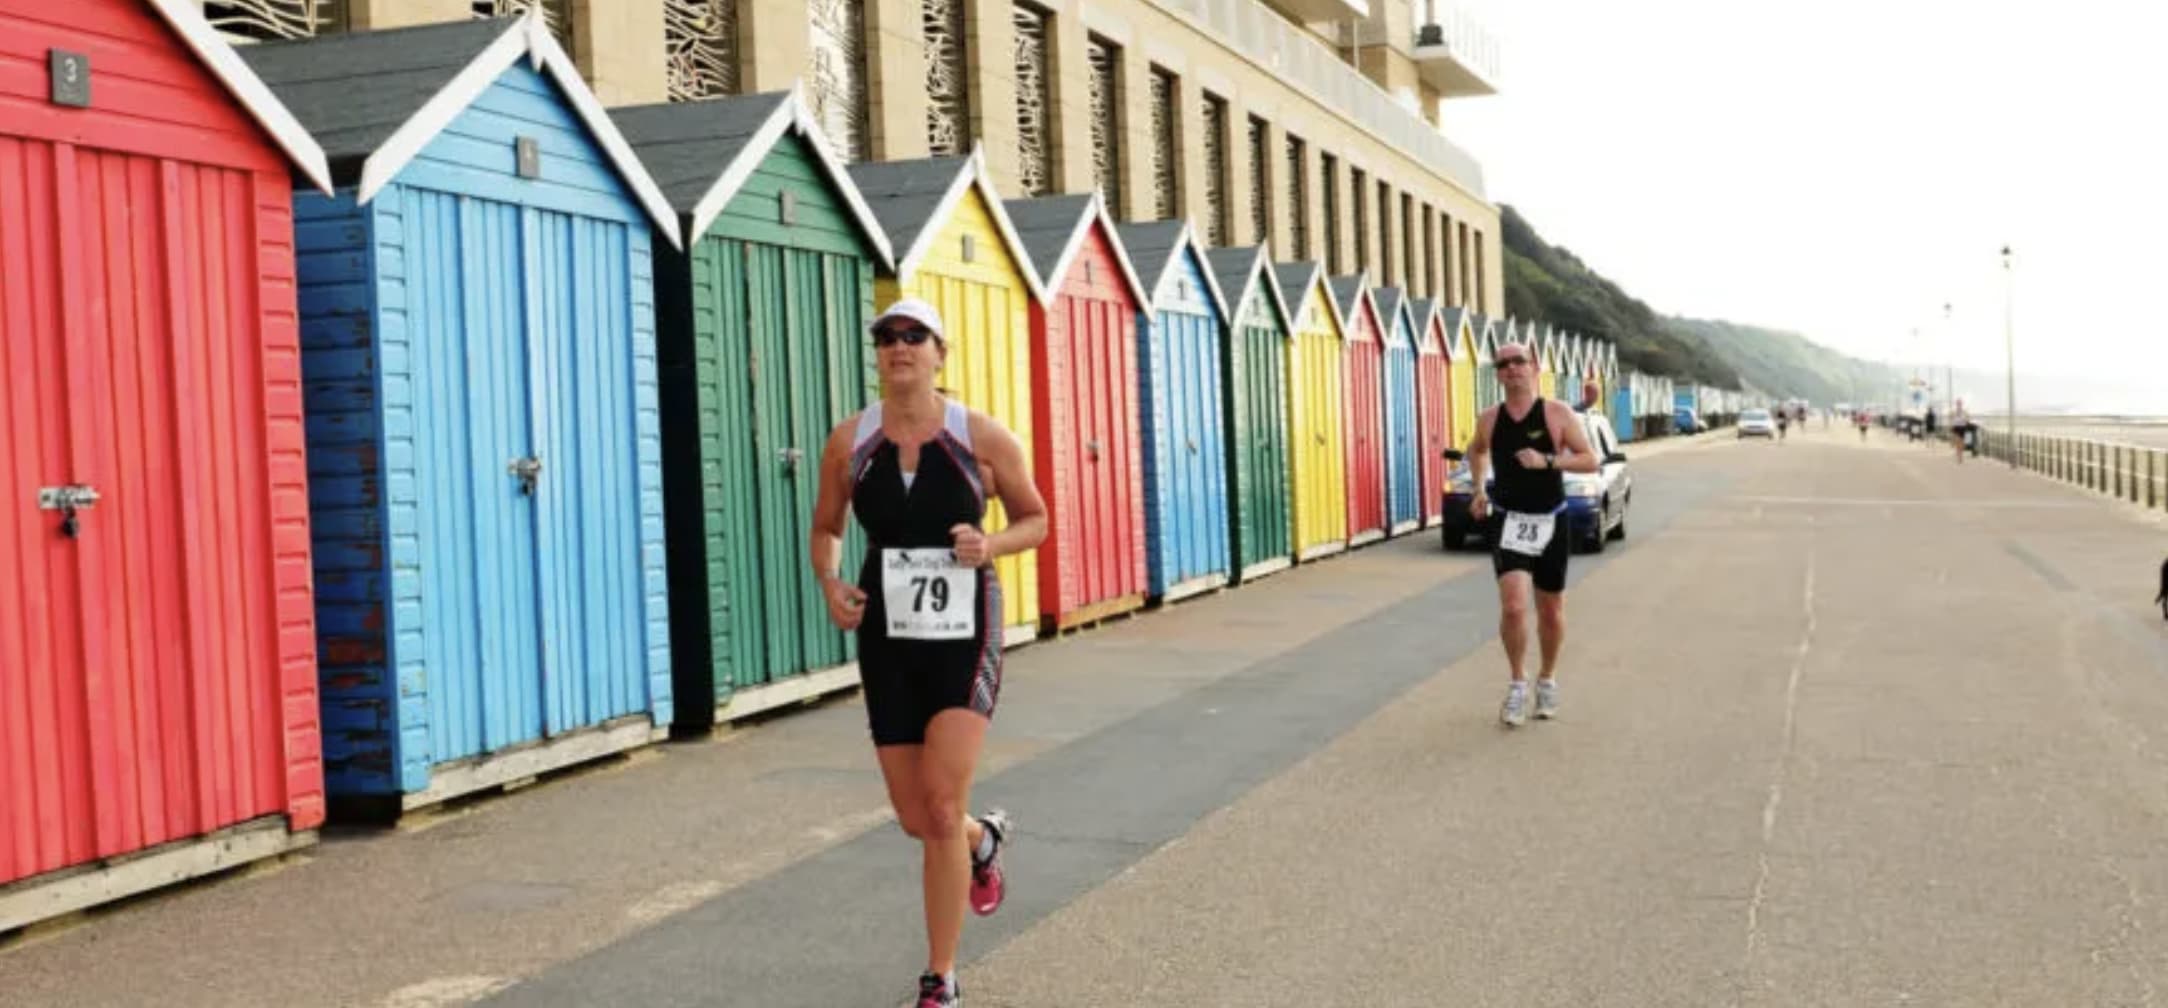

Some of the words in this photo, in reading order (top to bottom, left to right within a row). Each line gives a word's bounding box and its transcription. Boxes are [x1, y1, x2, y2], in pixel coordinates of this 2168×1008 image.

[64, 57, 77, 83] 3
[1516, 522, 1539, 543] 23
[910, 575, 950, 613] 79
